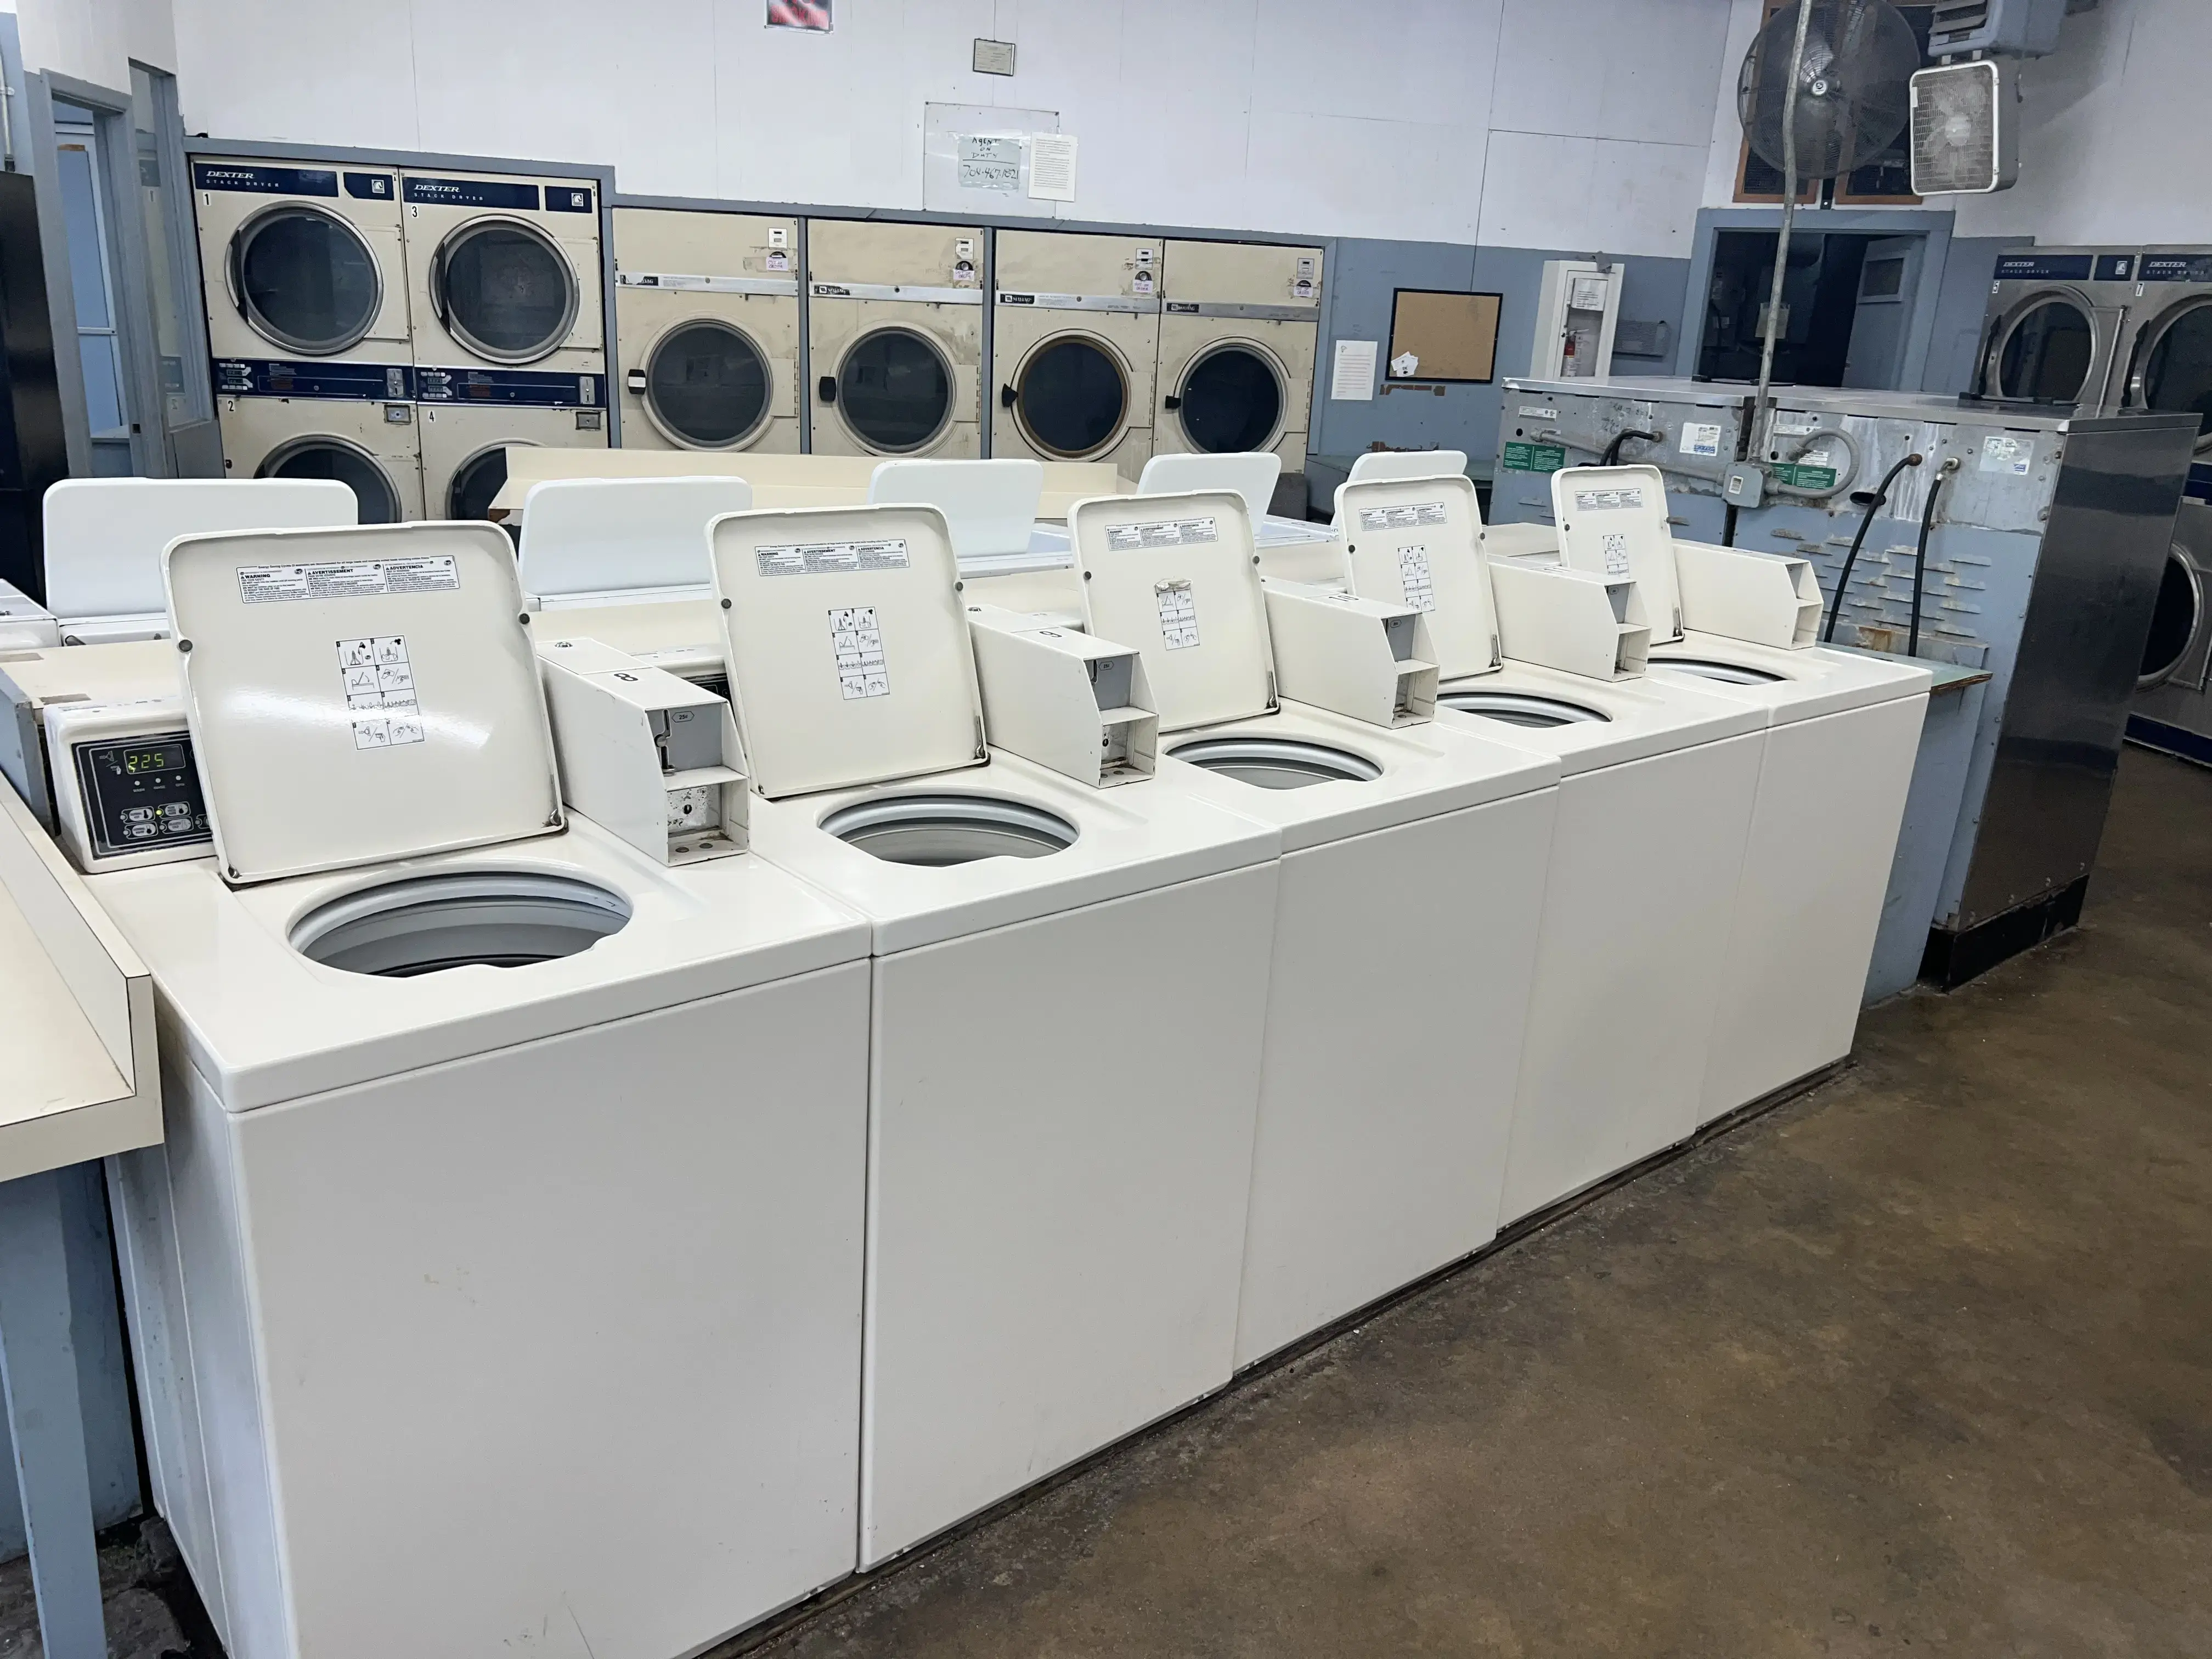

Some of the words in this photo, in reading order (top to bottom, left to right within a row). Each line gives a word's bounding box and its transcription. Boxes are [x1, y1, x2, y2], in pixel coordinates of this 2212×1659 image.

[206, 171, 255, 179] DEXTER
[204, 193, 209, 205] 1
[412, 206, 417, 217] 3
[2137, 283, 2143, 295] 7
[228, 400, 234, 411] 2
[430, 411, 435, 422] 4
[614, 673, 638, 681] 8
[128, 753, 163, 771] 225
